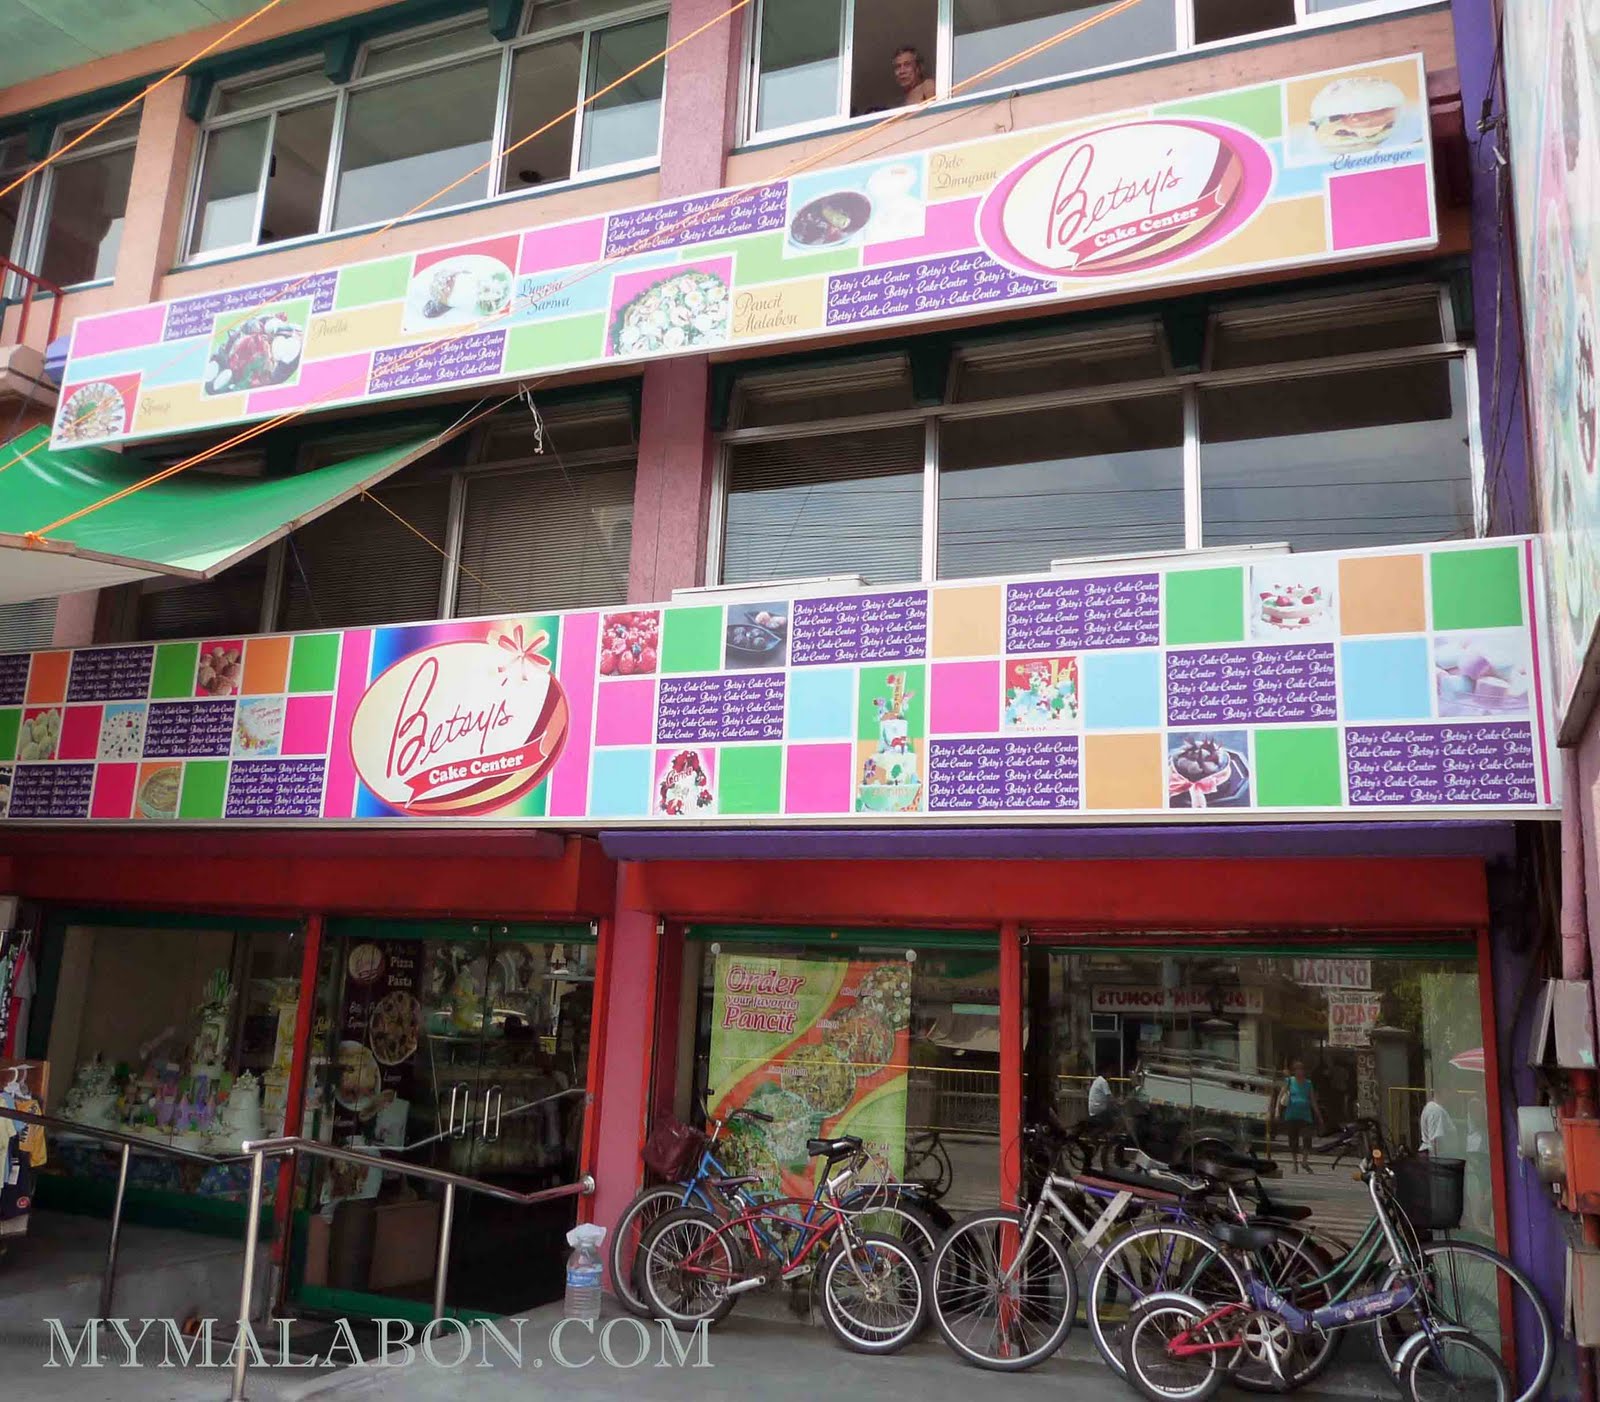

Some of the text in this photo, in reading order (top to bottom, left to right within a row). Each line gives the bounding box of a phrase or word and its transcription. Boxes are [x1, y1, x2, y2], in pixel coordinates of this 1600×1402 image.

[1330, 151, 1412, 170] Cheeseburger
[1046, 144, 1182, 249] Betsy's
[609, 216, 635, 231] Betsy's
[636, 213, 656, 225] Cake
[654, 209, 678, 221] Center
[683, 202, 709, 216] Betsy's
[760, 186, 786, 201] Betsy's
[609, 231, 627, 242] Cake
[626, 227, 649, 238] Center
[702, 212, 725, 225] Center
[730, 206, 757, 221] Betsy's
[759, 202, 779, 213] Cake
[652, 236, 675, 248] Center
[680, 229, 706, 243] Betsy's
[708, 226, 727, 237] Cake
[727, 223, 752, 234] Center
[757, 215, 784, 229] Betsy's
[1094, 207, 1199, 248] Cake Center
[830, 277, 858, 294] Betsy's
[861, 275, 882, 287] Cake
[882, 272, 910, 286] Center
[916, 263, 946, 279] Betsy's
[948, 260, 972, 273] Cake
[830, 294, 850, 307] Cake
[850, 291, 878, 304] Center
[885, 283, 913, 300] Betsy's
[916, 281, 939, 294] Cake
[939, 277, 967, 291] Center
[974, 269, 1005, 287] Betsy's
[735, 292, 782, 317] Pancit
[828, 280, 1039, 325] Betsy's Cake Center Betsy's Cake Center Betsy's
[734, 310, 798, 333] Malabon
[1008, 580, 1159, 601] Betsy's Cake Center Betsy's Cake Center
[794, 597, 926, 616] Betsy's Cake Center Betsy's Cake Center
[1008, 602, 1028, 612] Cake
[1028, 600, 1051, 611] Center
[1056, 598, 1082, 610] Betsy's
[1085, 596, 1106, 607] Cake
[1106, 595, 1130, 605] Center
[794, 616, 812, 626] Cake
[812, 615, 832, 625] Center
[837, 613, 859, 624] Betsy's
[862, 612, 880, 622] Cake
[880, 610, 901, 620] Center
[1168, 649, 1334, 668] Betsy's Cake Center Betsy's Cake Center
[1169, 669, 1190, 680] Cake
[1190, 668, 1216, 679] Center
[1222, 666, 1250, 679] Betsy's
[1253, 665, 1276, 676] Cake
[1276, 663, 1303, 675] Center
[661, 678, 785, 694] Betsy's Cake Center Betsy's Cake Center
[661, 694, 677, 704] Cake
[676, 693, 696, 703] Center
[700, 692, 721, 703] Betsy's
[724, 691, 741, 701] Cake
[741, 690, 760, 700] Center
[386, 657, 514, 779] Betsy's
[1347, 727, 1532, 746] Betsy's Cake Center Betsy's Cake Center
[930, 742, 1078, 757] Betsy's Cake Center Betsy's Cake Center
[1348, 746, 1373, 758] Cake
[1372, 745, 1401, 757] Center
[1408, 743, 1439, 758] Betsy's
[1442, 743, 1468, 756] Cake
[1468, 742, 1498, 755] Center
[428, 753, 524, 785] Cake Center
[931, 758, 950, 768] Cake
[950, 757, 973, 768] Center
[978, 756, 1003, 769] Betsy's
[1006, 756, 1026, 767] Cake
[1026, 755, 1049, 766] Center
[390, 957, 414, 968] Pizza
[388, 976, 412, 987] Pasta
[726, 966, 806, 995] Order
[726, 995, 800, 1010] your favorite
[722, 1006, 796, 1034] Pancit
